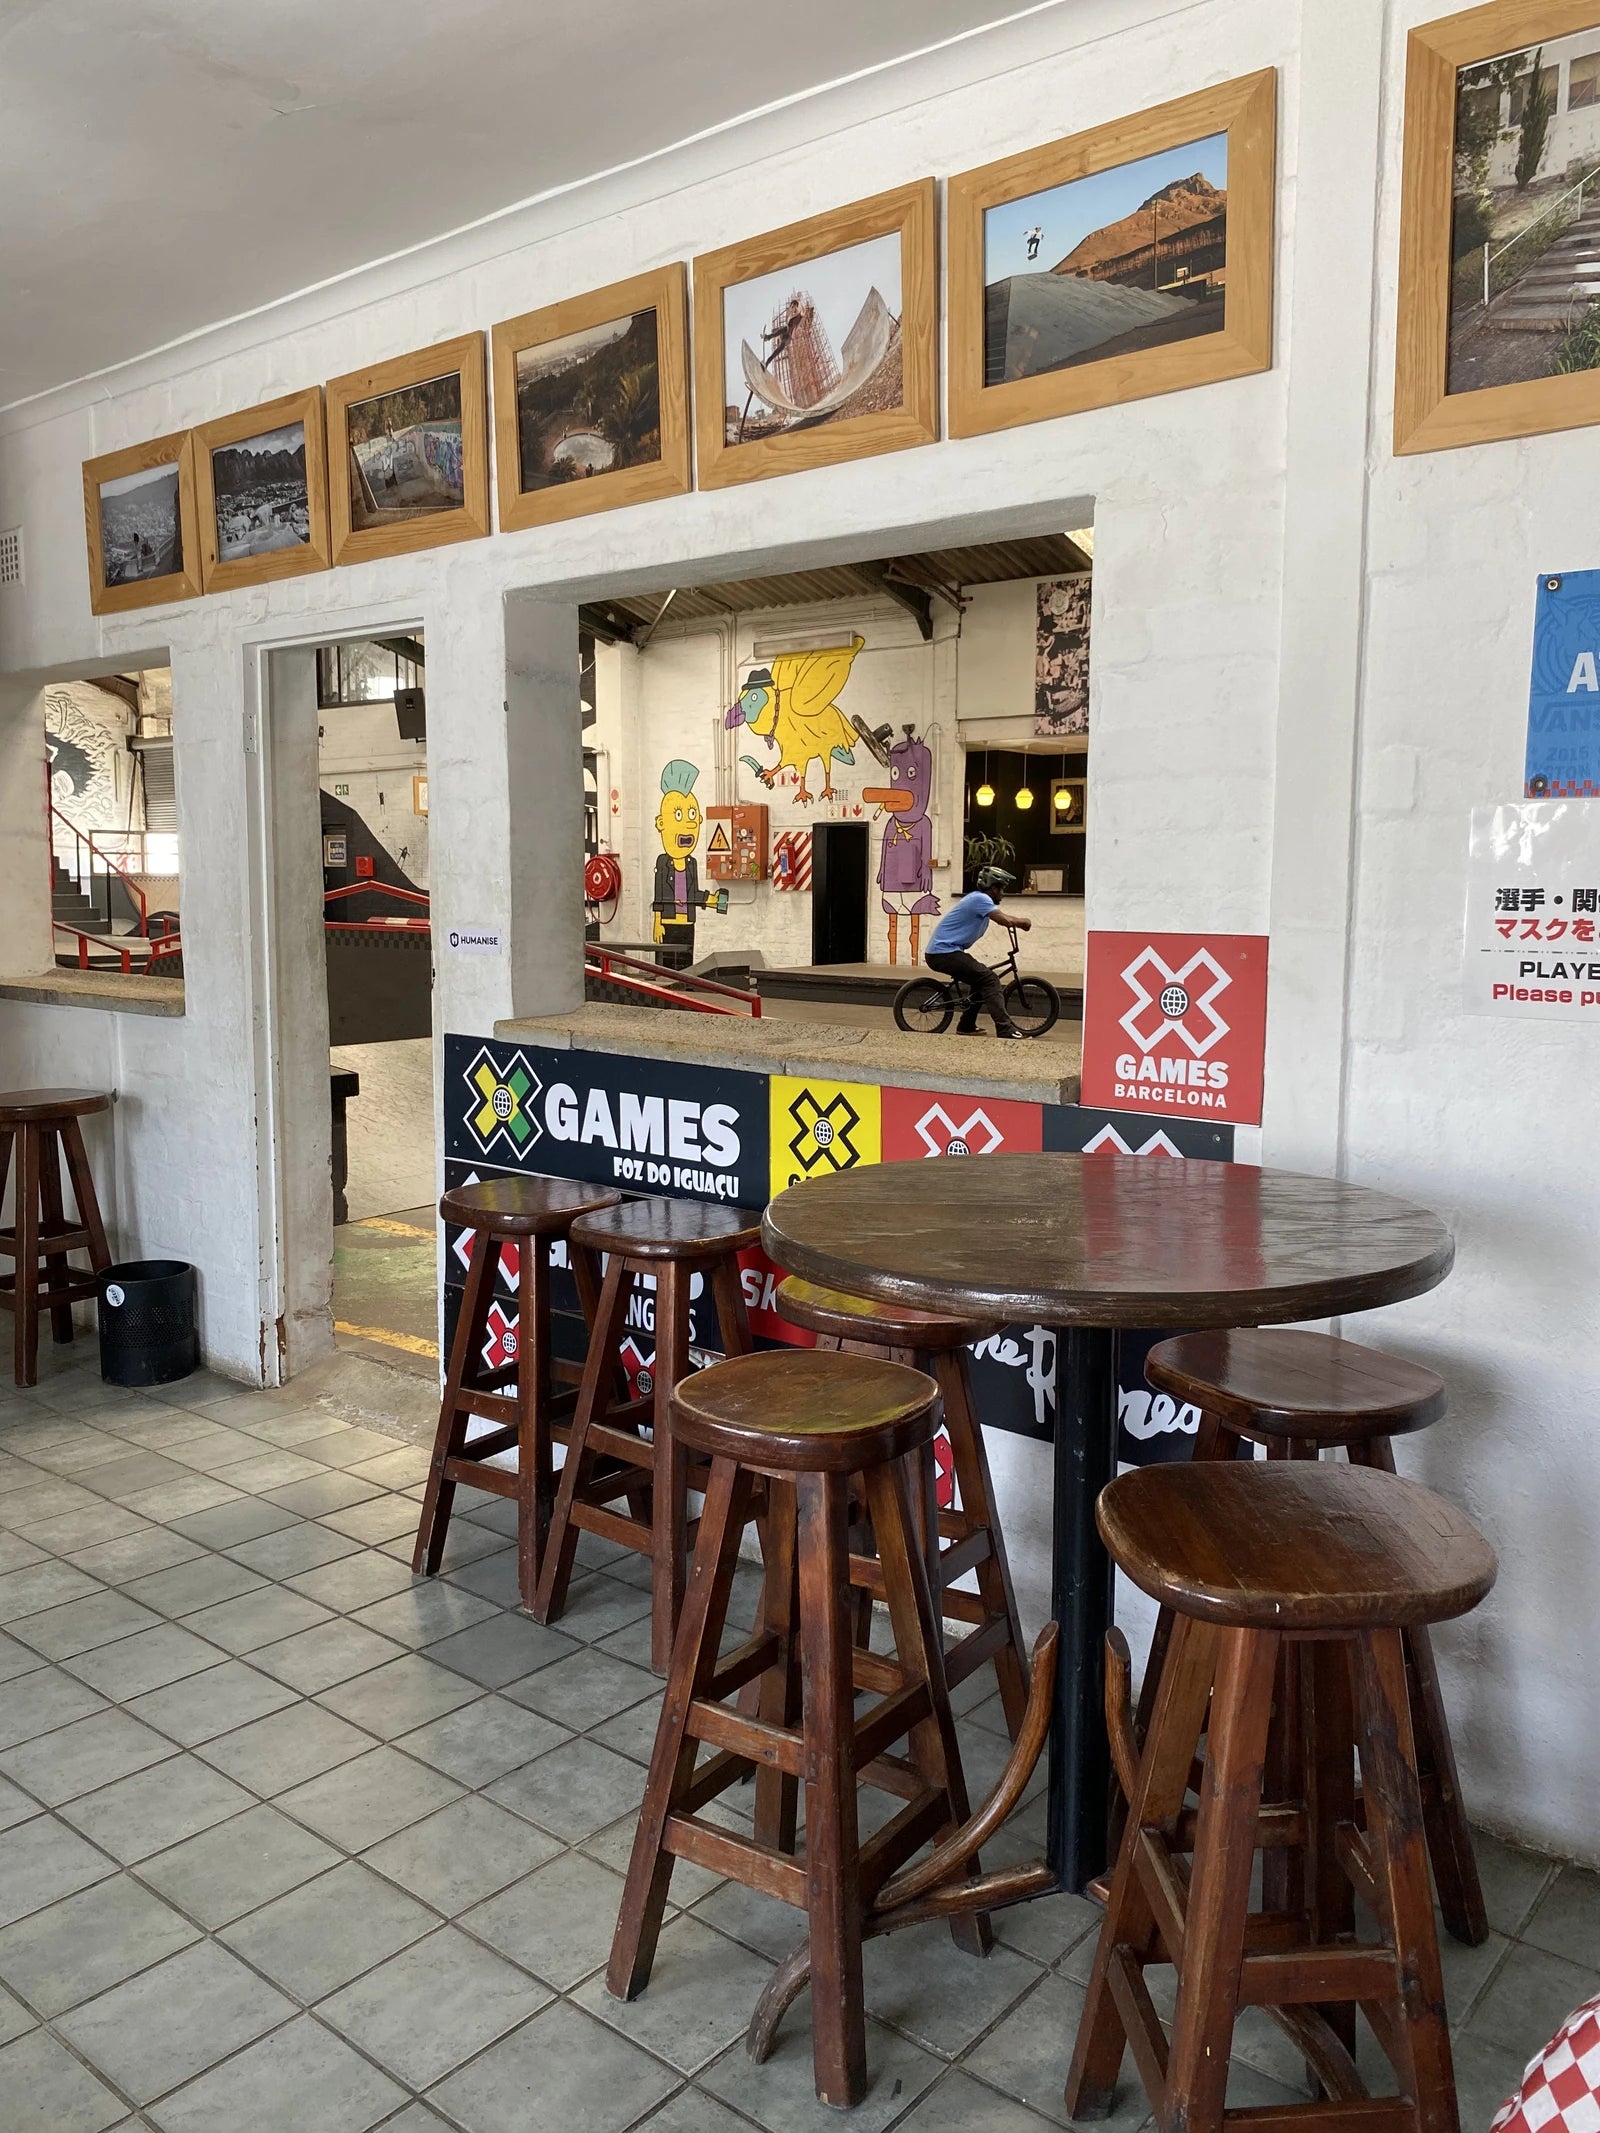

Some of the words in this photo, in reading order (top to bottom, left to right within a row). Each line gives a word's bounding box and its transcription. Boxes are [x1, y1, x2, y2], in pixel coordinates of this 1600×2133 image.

[1495, 888, 1600, 913] 選手・関
[460, 936, 499, 946] HUMANISE
[1495, 918, 1600, 942] マスクを
[1519, 961, 1600, 980] PLAYE
[1493, 983, 1573, 1003] Please
[1115, 1053, 1229, 1089] GAMES
[1114, 1083, 1227, 1109] BARCELONA
[544, 1082, 741, 1168] GAMES
[613, 1156, 645, 1181] FOZ
[647, 1161, 672, 1187] DO
[673, 1166, 740, 1200] IGUAÇU
